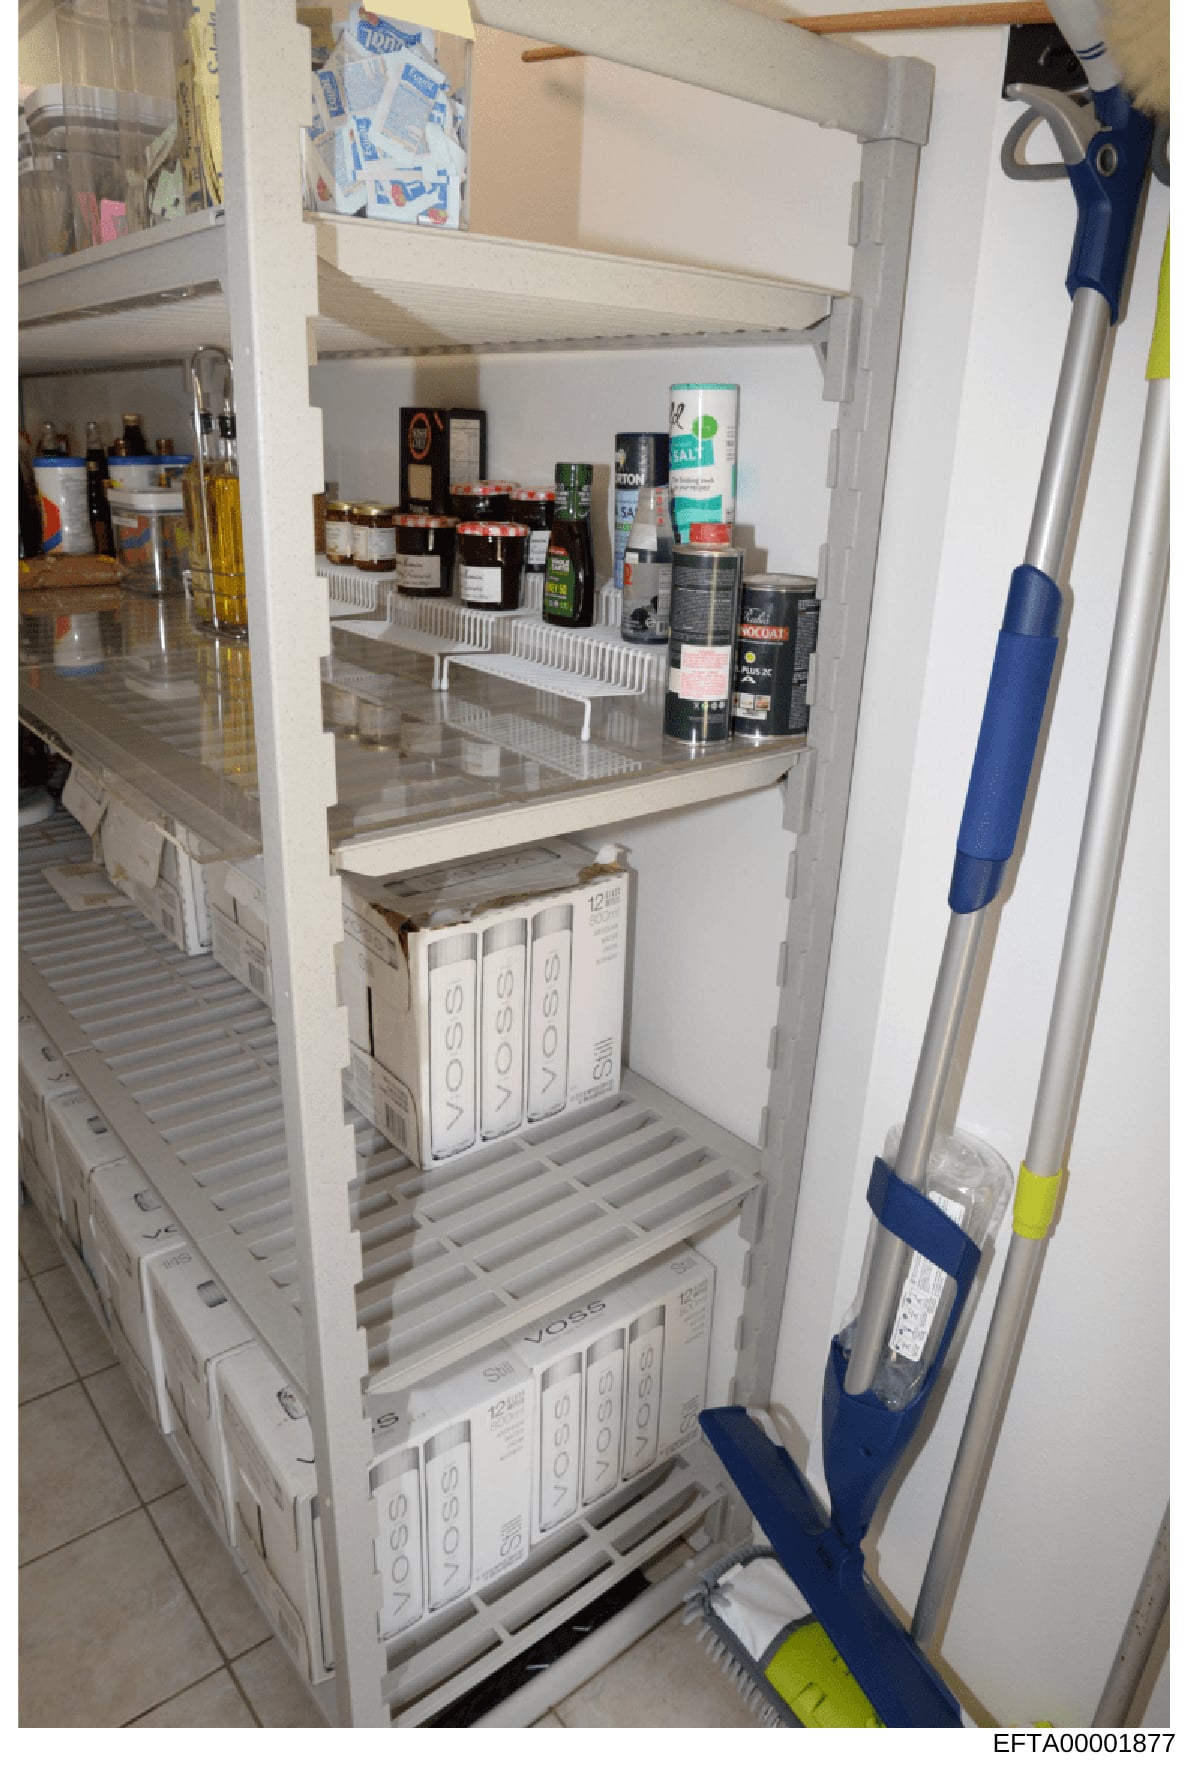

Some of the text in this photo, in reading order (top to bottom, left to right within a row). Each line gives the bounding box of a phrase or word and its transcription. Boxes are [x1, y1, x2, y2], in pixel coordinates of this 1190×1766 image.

[674, 446, 704, 462] SALT
[587, 893, 604, 912] 12
[445, 983, 464, 1131] VOSS
[495, 968, 513, 1113] VOSS
[541, 952, 560, 1095] VOSS
[592, 1037, 613, 1081] Still
[482, 1360, 515, 1383] Still
[524, 1300, 606, 1344] VOSS
[487, 1399, 504, 1420] 12
[553, 1393, 570, 1508] VOSS
[596, 1368, 613, 1483] VOSS
[635, 1344, 654, 1458] VOSS
[388, 1492, 411, 1617] VOSS
[440, 1463, 460, 1588] VOSS
[500, 1514, 521, 1557] Still
